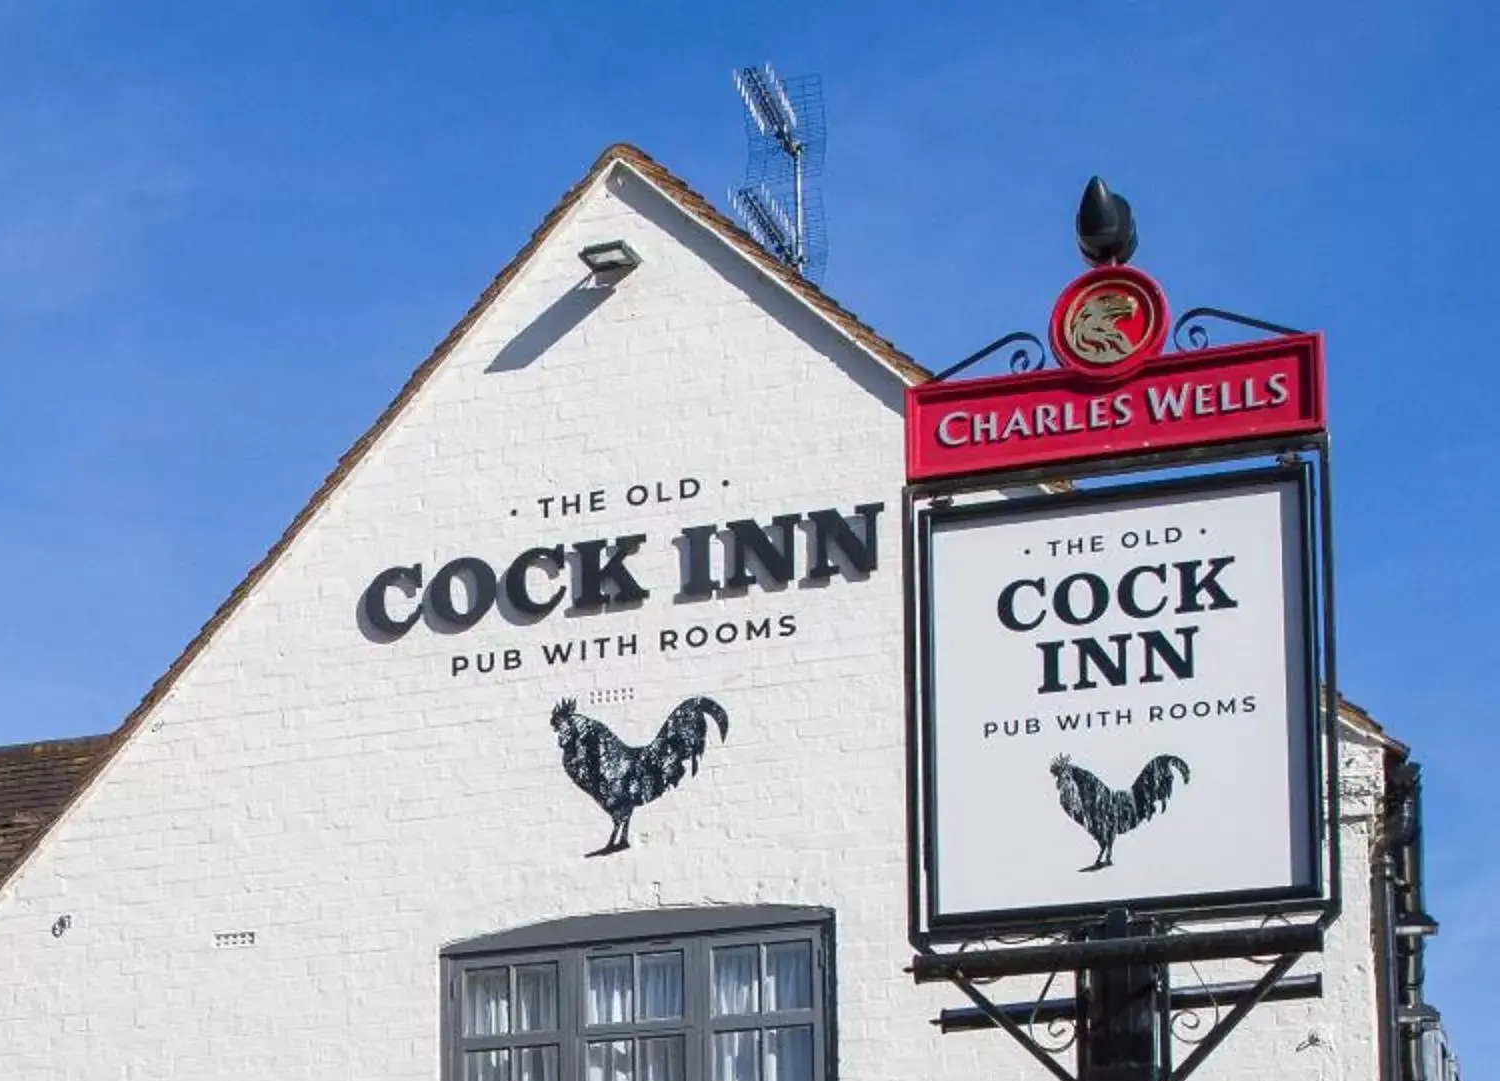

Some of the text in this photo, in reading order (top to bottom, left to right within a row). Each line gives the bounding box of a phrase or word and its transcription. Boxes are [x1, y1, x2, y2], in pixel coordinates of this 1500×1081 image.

[938, 373, 1288, 446] CHARLES WELLS
[537, 477, 701, 519] THE OLD
[361, 501, 885, 640] COCK INN
[1047, 526, 1183, 557] THE OLD
[996, 555, 1239, 633] COCK
[451, 614, 797, 677] PUB WITH ROOMS
[1036, 625, 1199, 694] INN
[983, 695, 1257, 739] PUB WITH ROOMS
